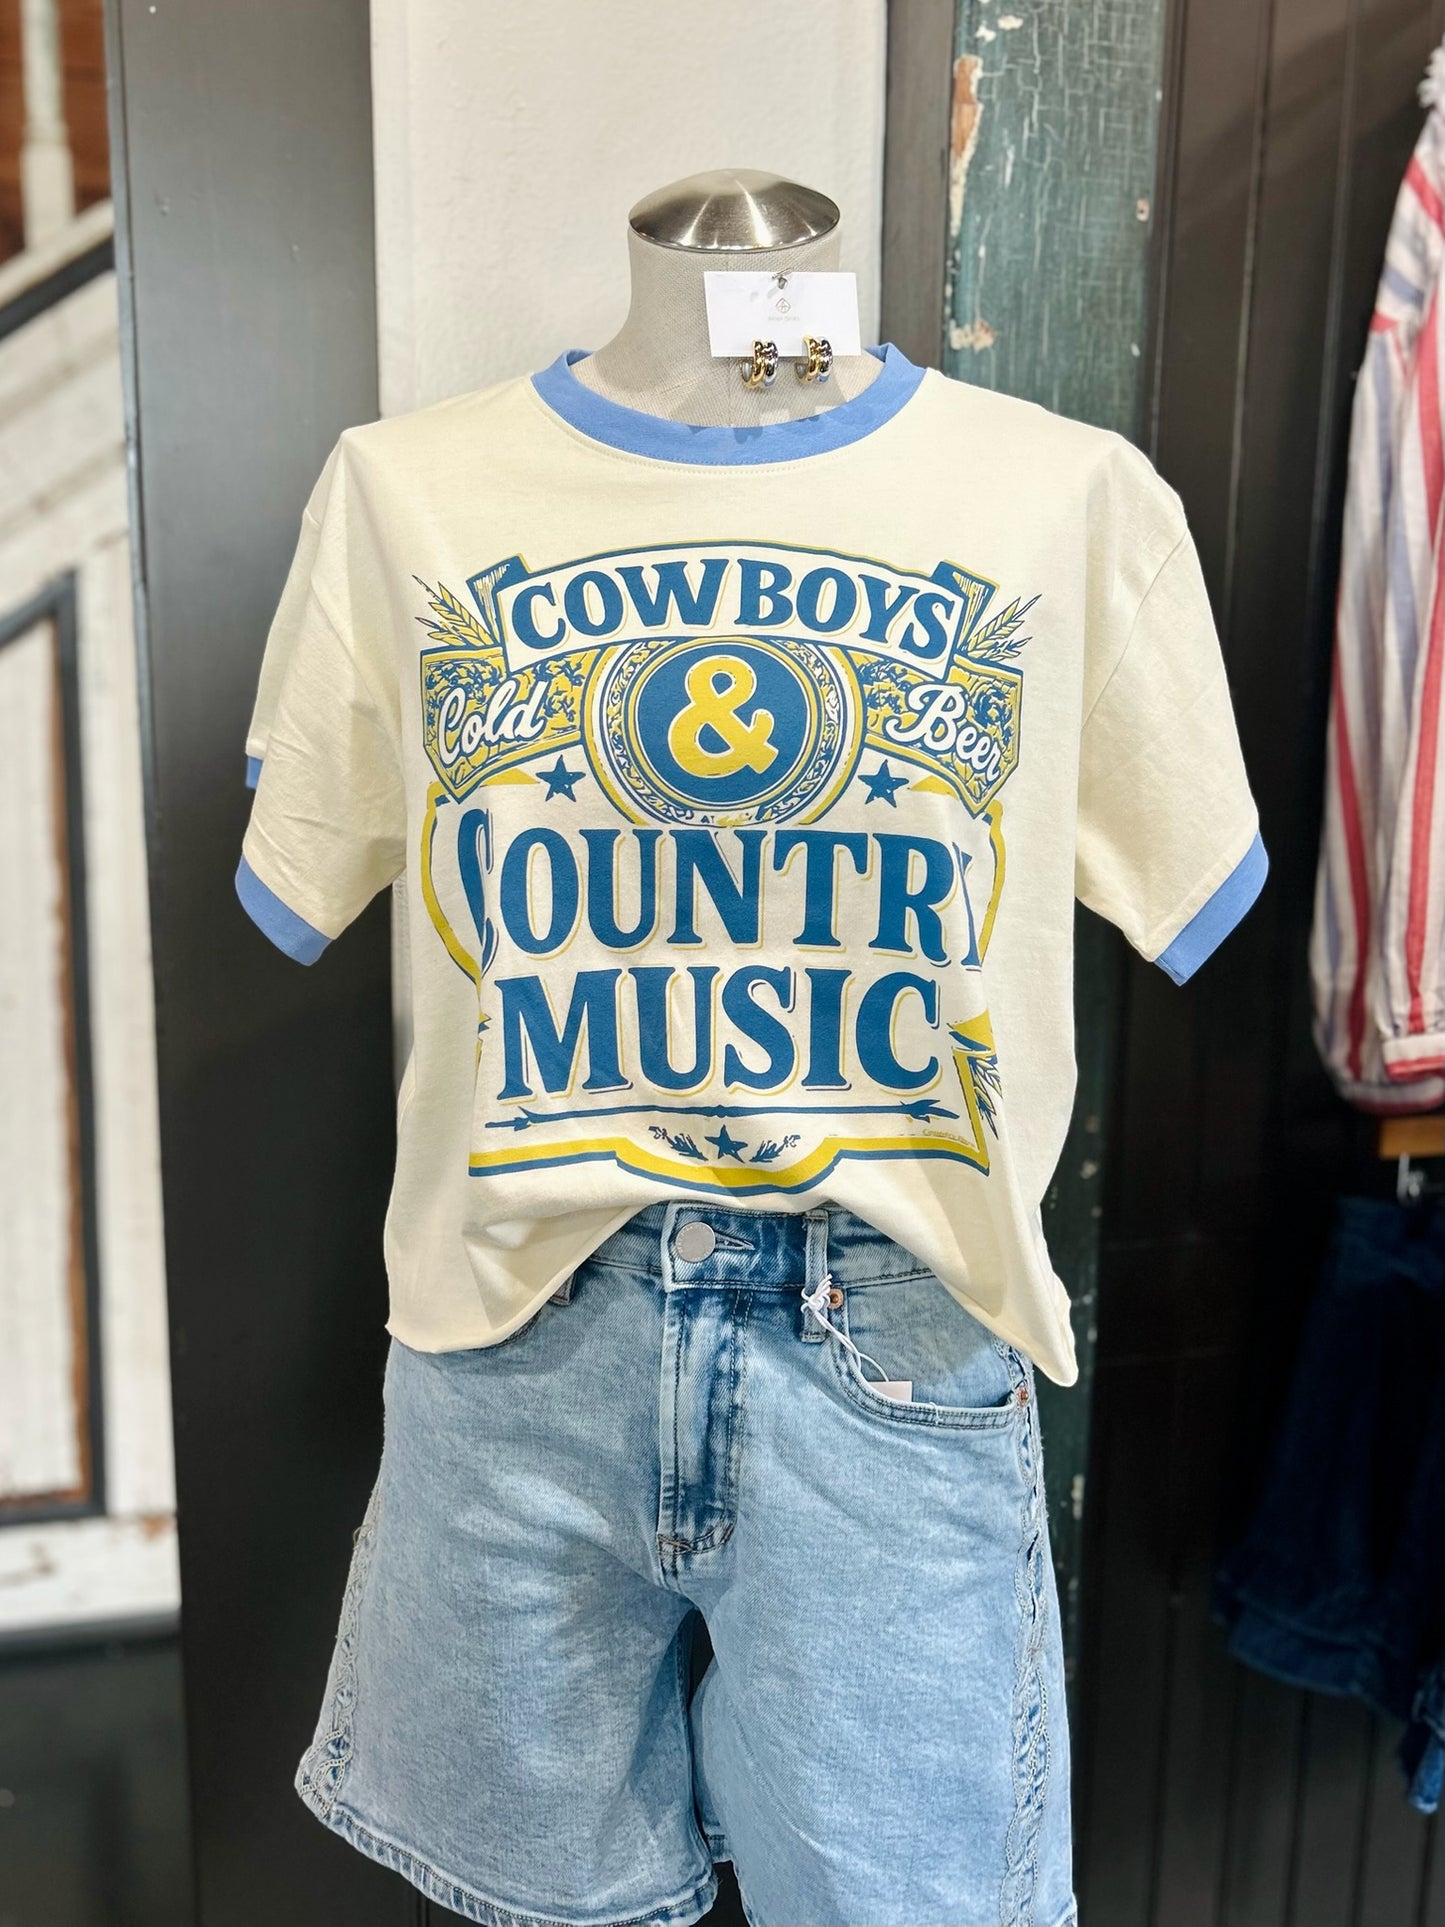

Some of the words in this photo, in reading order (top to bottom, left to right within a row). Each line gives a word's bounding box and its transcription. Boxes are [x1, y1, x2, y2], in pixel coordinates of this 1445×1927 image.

[511, 558, 955, 660] COWBOYS
[439, 678, 546, 766] Cold
[667, 654, 779, 779] &
[884, 684, 1002, 782] Beer
[494, 965, 942, 1100] MUSIC
